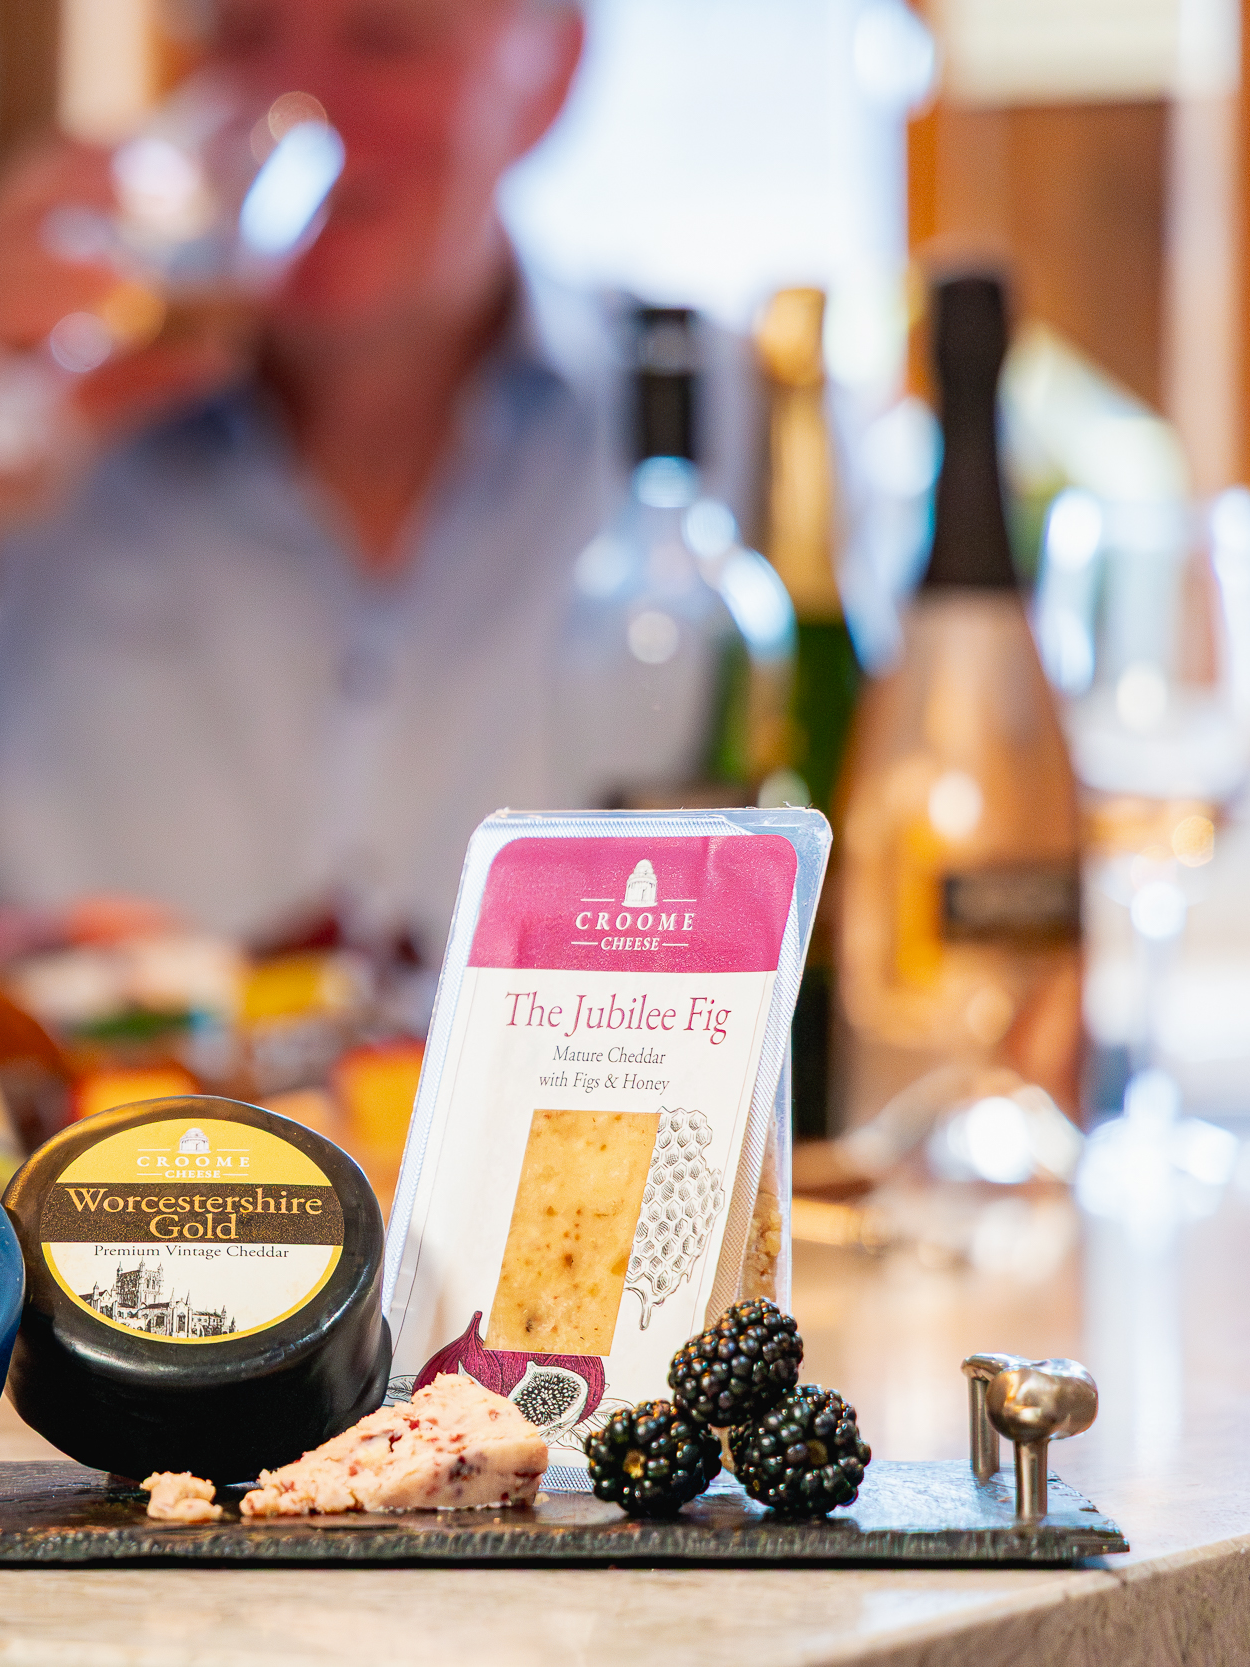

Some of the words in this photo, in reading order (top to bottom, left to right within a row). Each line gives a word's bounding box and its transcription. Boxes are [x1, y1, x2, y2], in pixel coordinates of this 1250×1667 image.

[575, 911, 695, 932] CROOME
[600, 936, 660, 951] CHEESE
[504, 990, 563, 1027] The
[564, 993, 677, 1037] Jubilee
[683, 996, 732, 1045] Fig
[552, 1045, 604, 1064] Mature
[607, 1046, 666, 1065] Cheddar
[539, 1071, 568, 1088] with
[572, 1073, 601, 1094] Figs
[604, 1074, 620, 1090] &
[622, 1074, 670, 1095] Honey
[137, 1156, 250, 1168] CROOME
[164, 1169, 222, 1179] CHEESE
[65, 1187, 323, 1215] Worcestershire
[149, 1213, 239, 1240] Gold
[94, 1245, 160, 1258] Premium
[165, 1245, 222, 1260] Vintage
[225, 1245, 289, 1259] Cheddar
